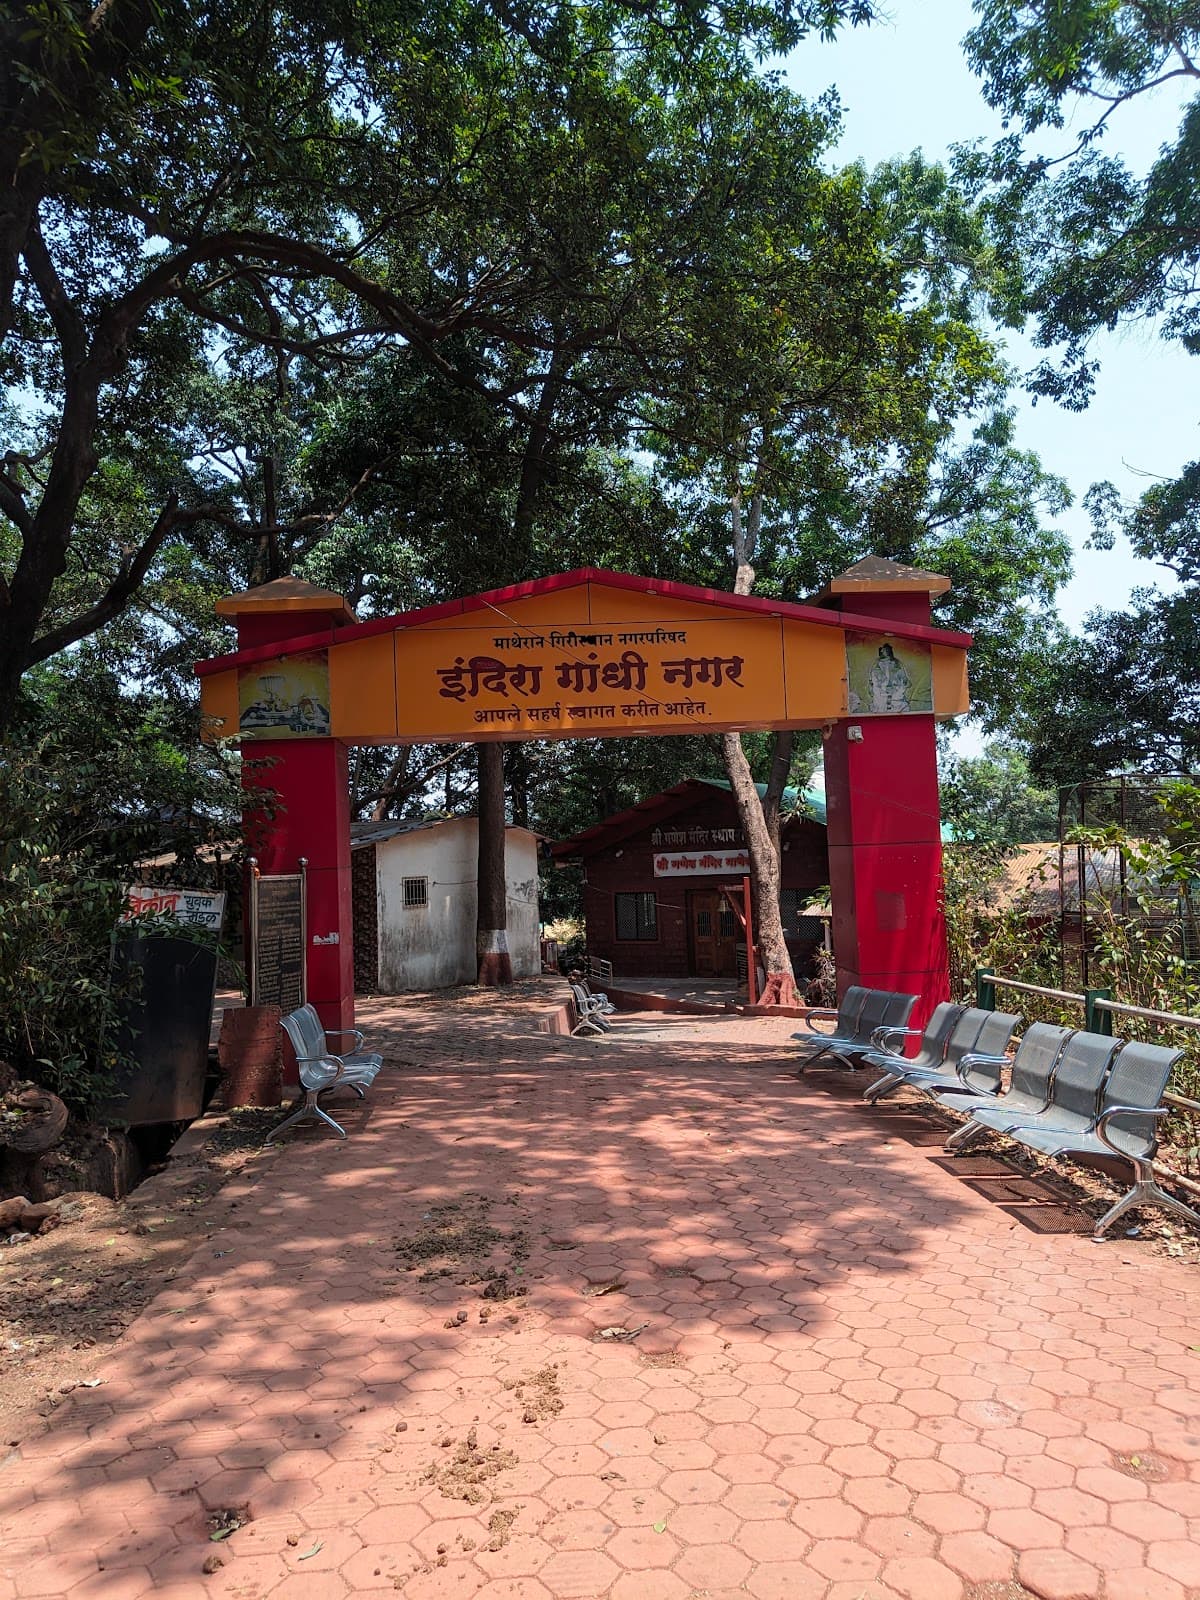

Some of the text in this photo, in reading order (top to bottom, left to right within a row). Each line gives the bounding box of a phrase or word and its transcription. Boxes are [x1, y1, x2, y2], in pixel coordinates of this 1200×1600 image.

[492, 632, 545, 650] माथेरान
[618, 628, 687, 645] नगरपरिषद
[437, 650, 745, 703] इंदिरा गांधी नगर
[473, 704, 521, 723] आपले
[527, 701, 561, 721] सहर्ष
[567, 704, 615, 721] स्वागत
[621, 699, 659, 718] करीत
[184, 895, 216, 909] युवक
